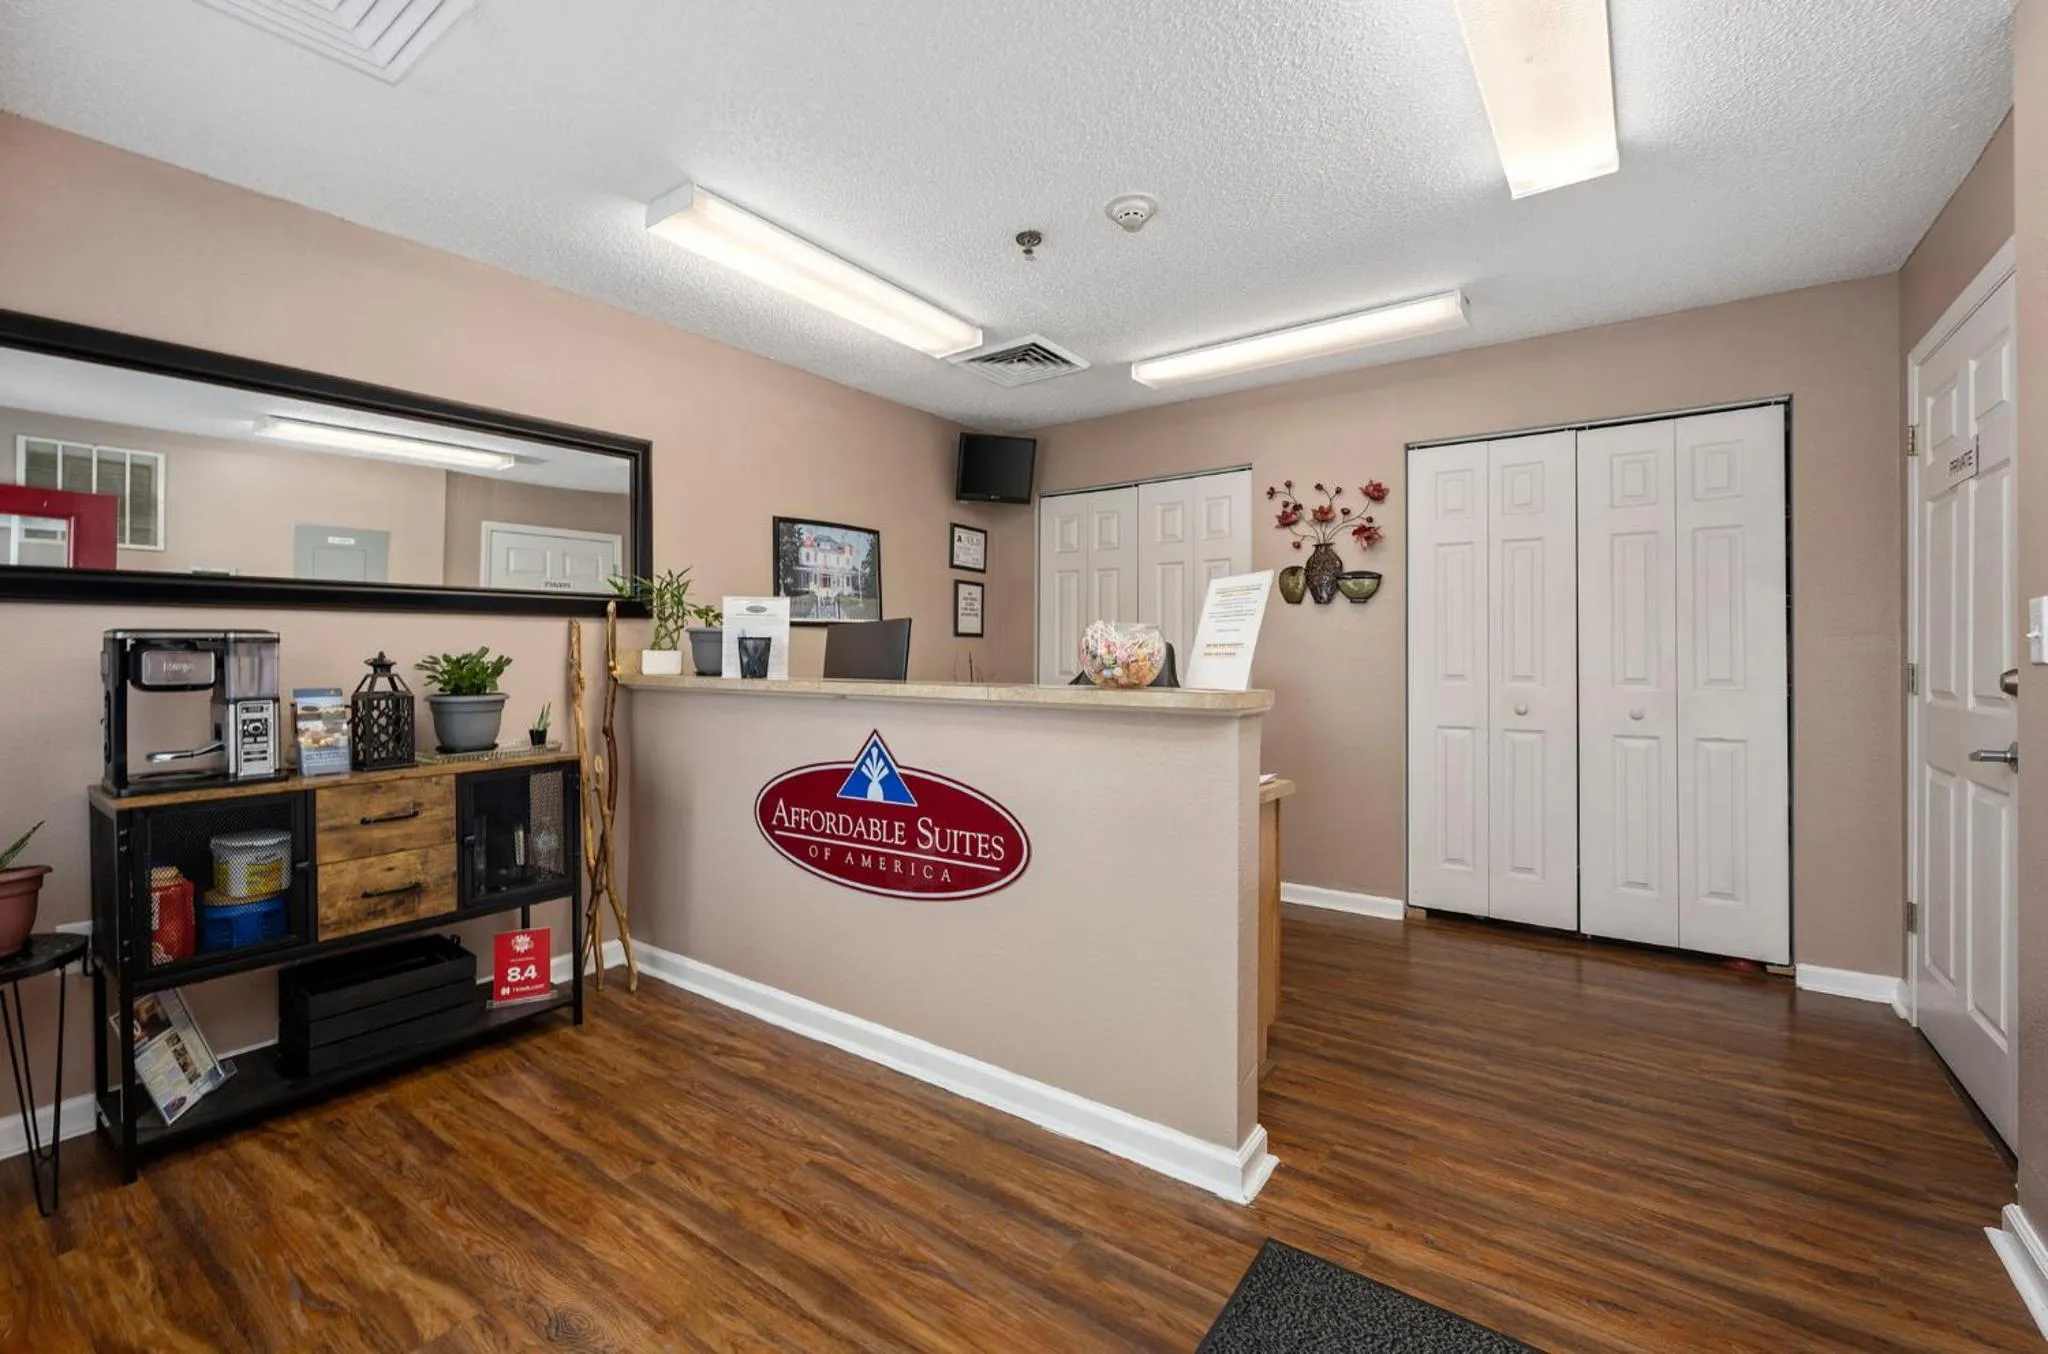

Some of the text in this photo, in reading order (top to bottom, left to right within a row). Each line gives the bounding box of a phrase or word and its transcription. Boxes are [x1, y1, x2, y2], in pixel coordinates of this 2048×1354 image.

[772, 798, 1005, 861] AFFORDABLE SUITES
[809, 845, 951, 882] OF AMERICA
[507, 964, 537, 982] 8.4
